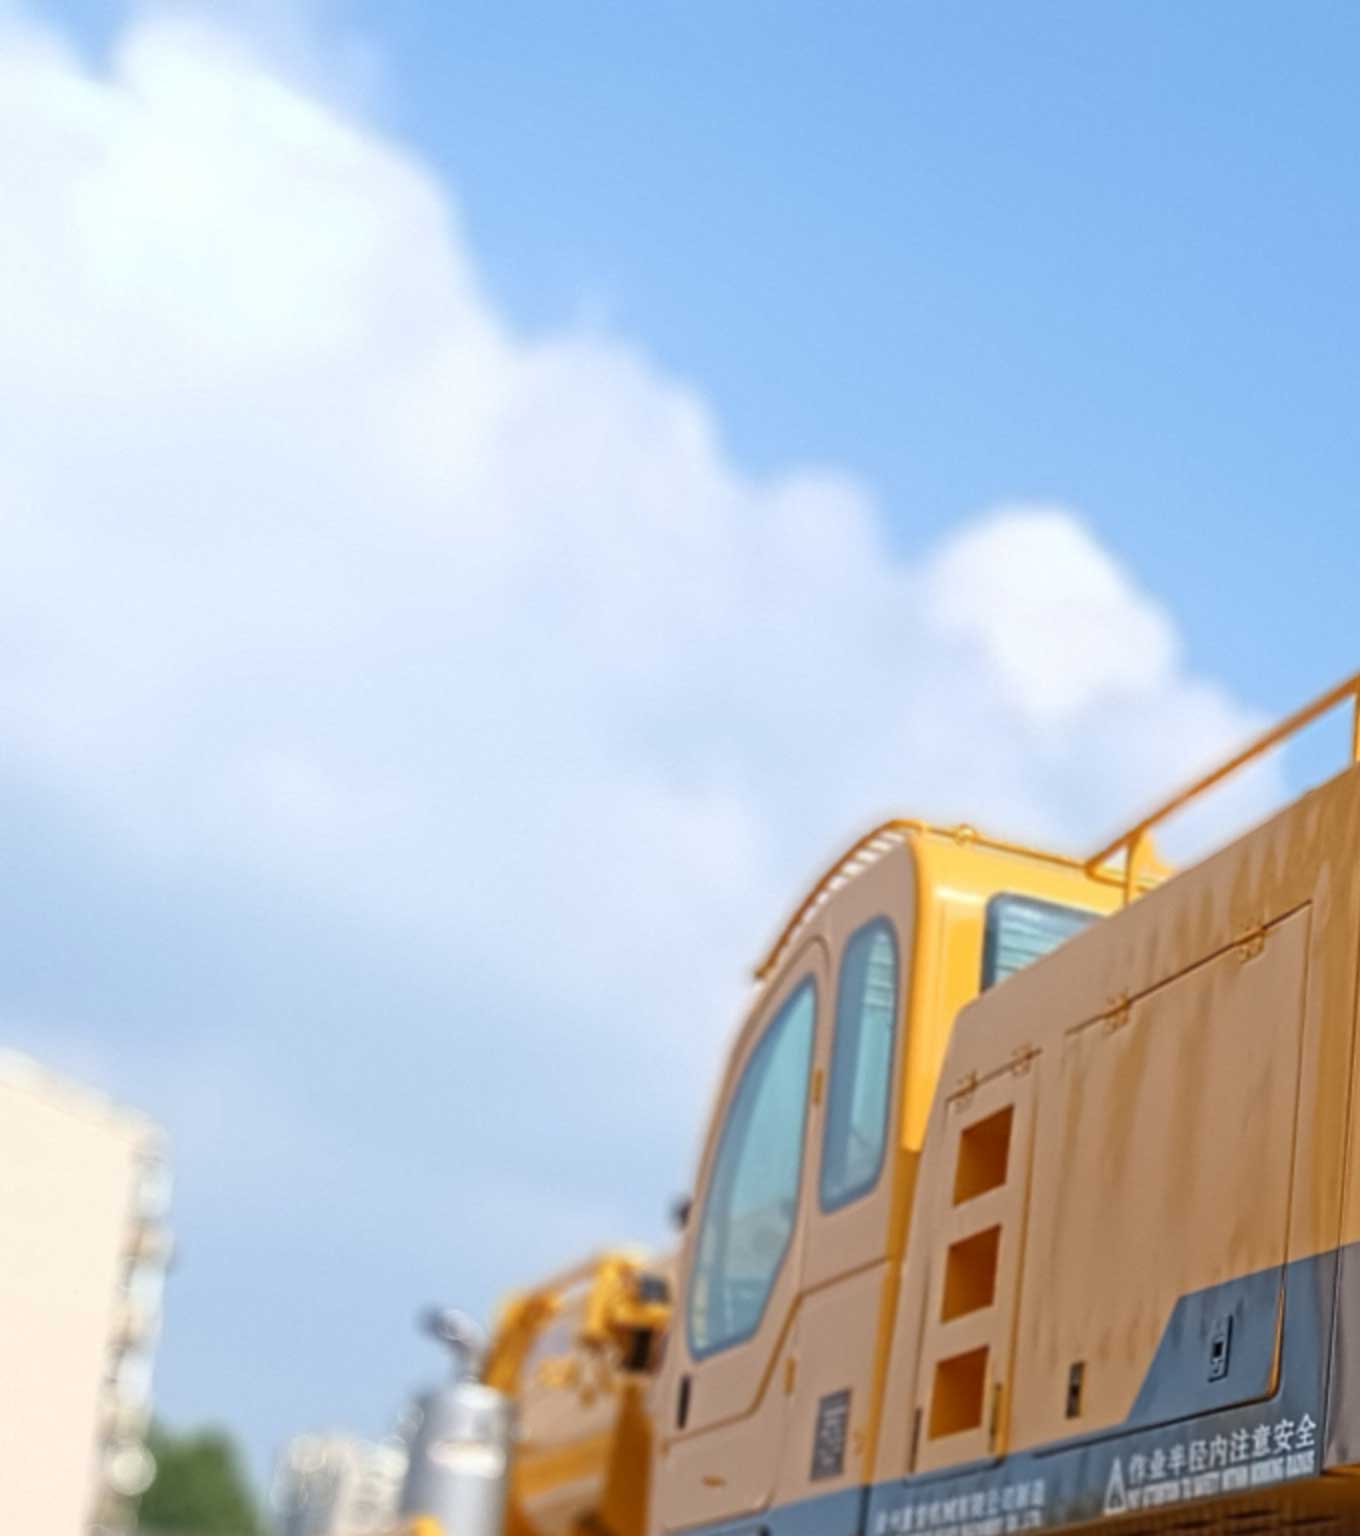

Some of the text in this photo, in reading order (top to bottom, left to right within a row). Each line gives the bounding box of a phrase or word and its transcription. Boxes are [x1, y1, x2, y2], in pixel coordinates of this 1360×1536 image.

[1128, 1412, 1317, 1484] 作业半径内注意安全
